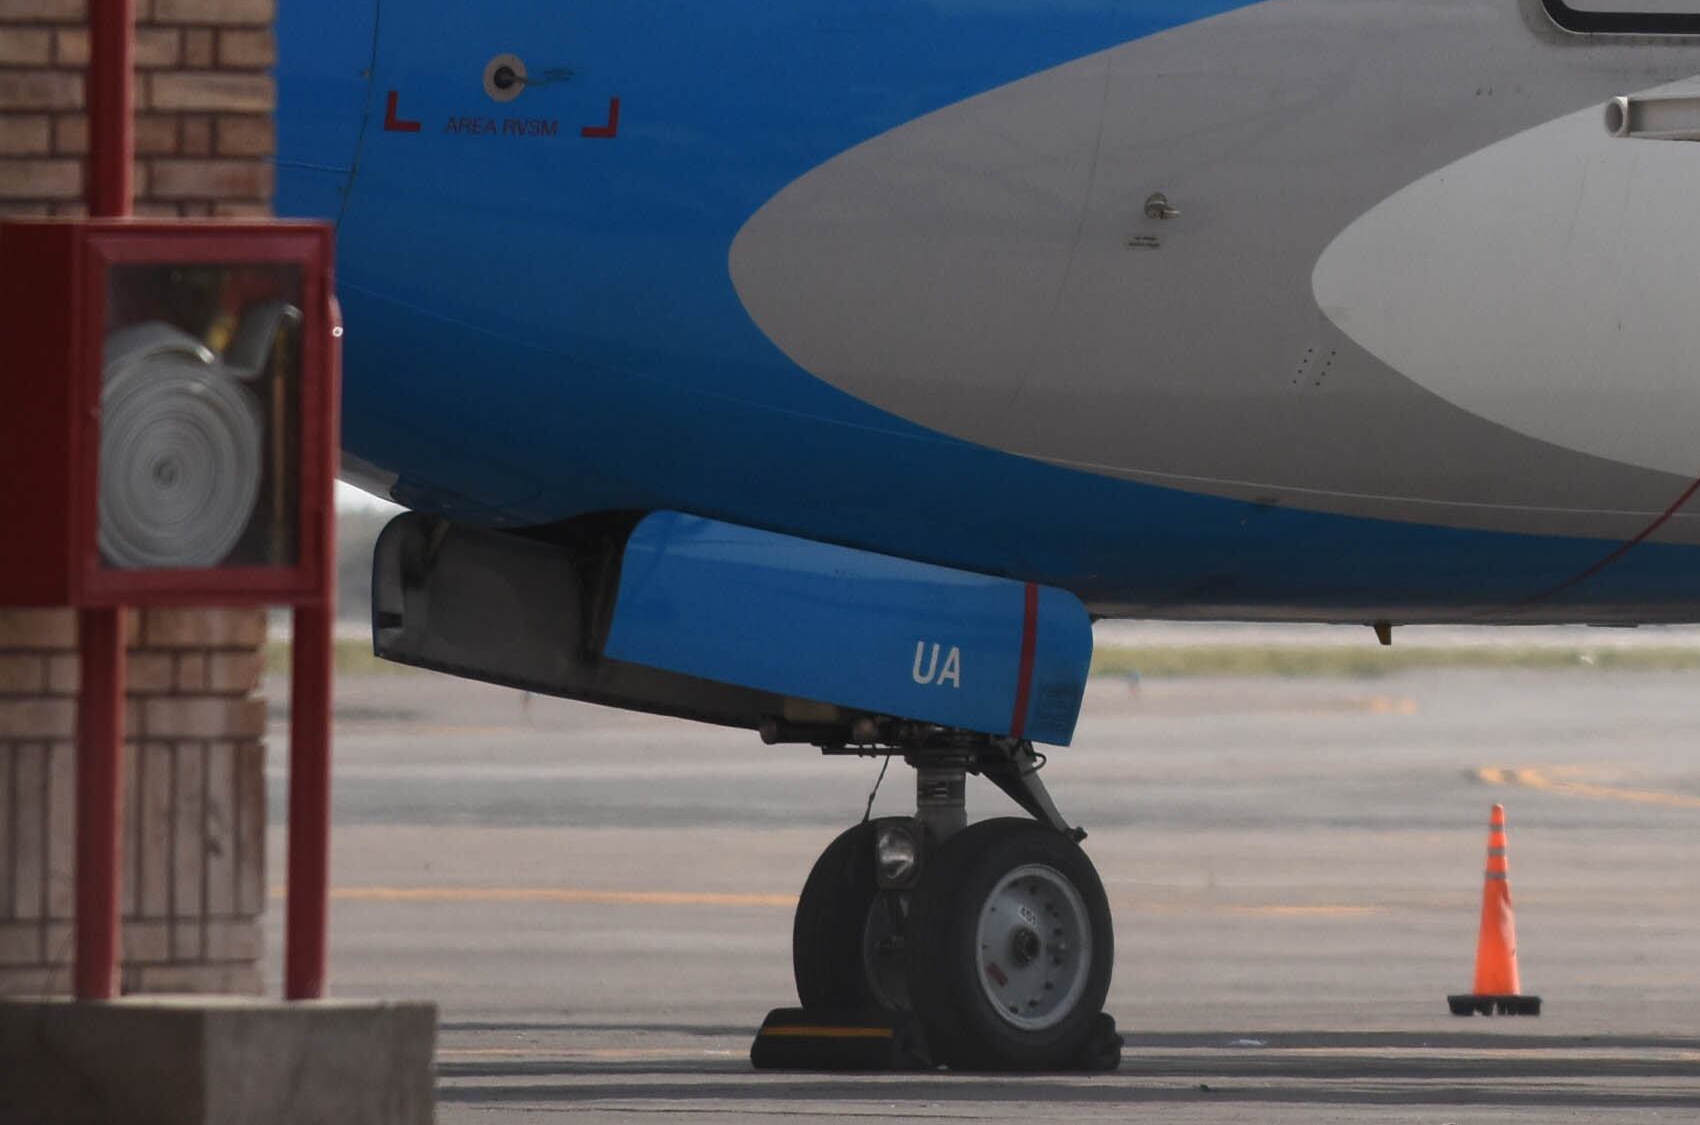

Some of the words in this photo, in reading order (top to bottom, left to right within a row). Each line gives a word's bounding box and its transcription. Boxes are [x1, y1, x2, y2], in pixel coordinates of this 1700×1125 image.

[444, 116, 497, 135] AREA
[503, 118, 559, 137] RVSM
[912, 641, 961, 688] UA
